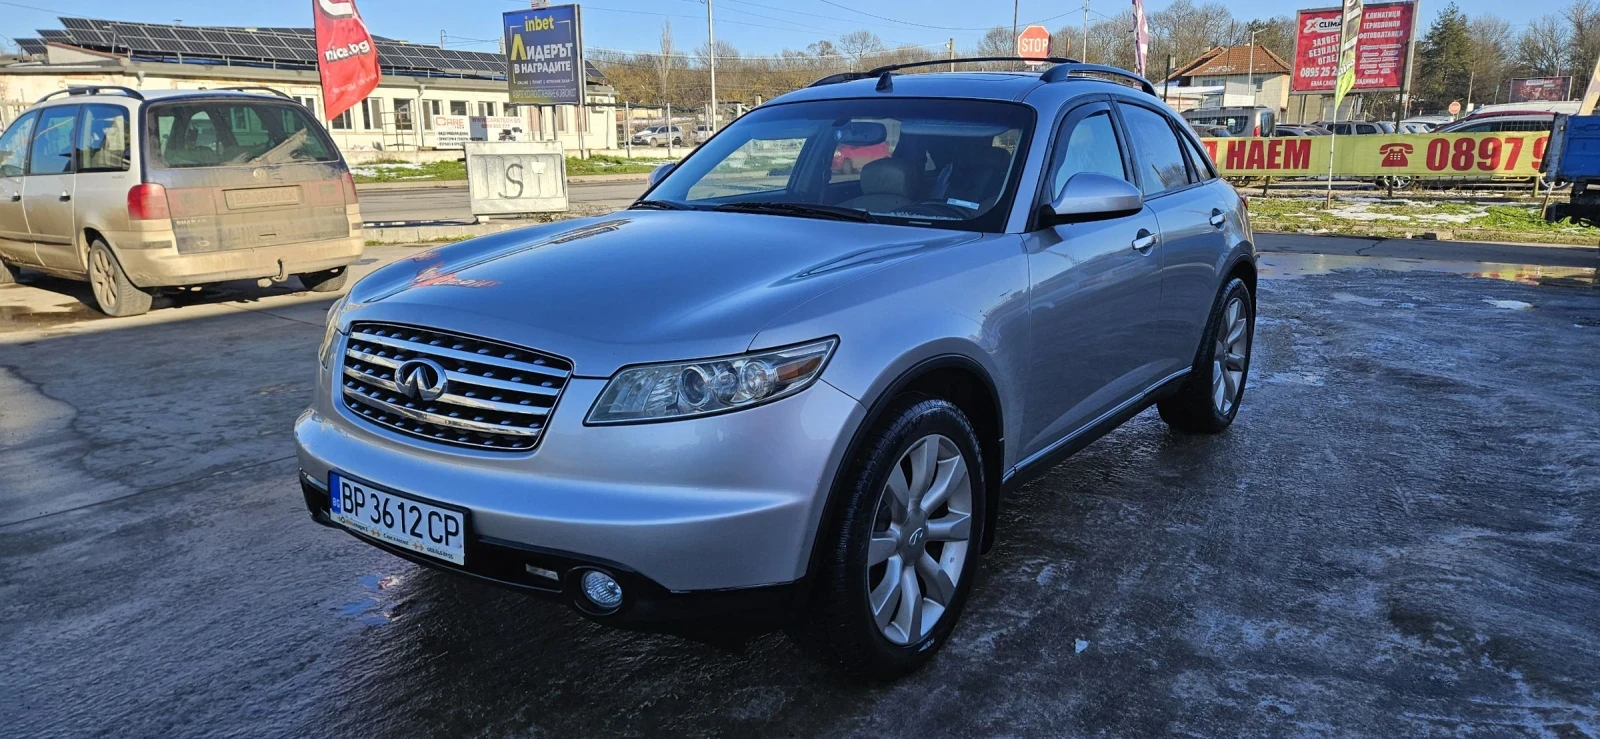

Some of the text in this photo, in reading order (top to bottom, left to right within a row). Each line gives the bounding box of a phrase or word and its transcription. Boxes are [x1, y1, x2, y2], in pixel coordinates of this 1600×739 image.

[1365, 10, 1401, 19] КЛИМАТИЦИ
[525, 15, 554, 32] inbet
[511, 34, 573, 61] ЛИДЕРЪТ
[1021, 38, 1049, 53] STOP
[1312, 34, 1340, 46] ЗАЯВЕТ
[325, 40, 370, 62] nice.bg
[514, 61, 571, 74] В НАГРАДИТЕ
[1300, 66, 1320, 77] 0895
[1320, 66, 1331, 77] 25
[1226, 139, 1312, 170] НАЕМ
[1426, 136, 1524, 171] 0897
[342, 481, 365, 517] BP
[370, 493, 423, 539] 3612
[427, 510, 460, 547] CP
